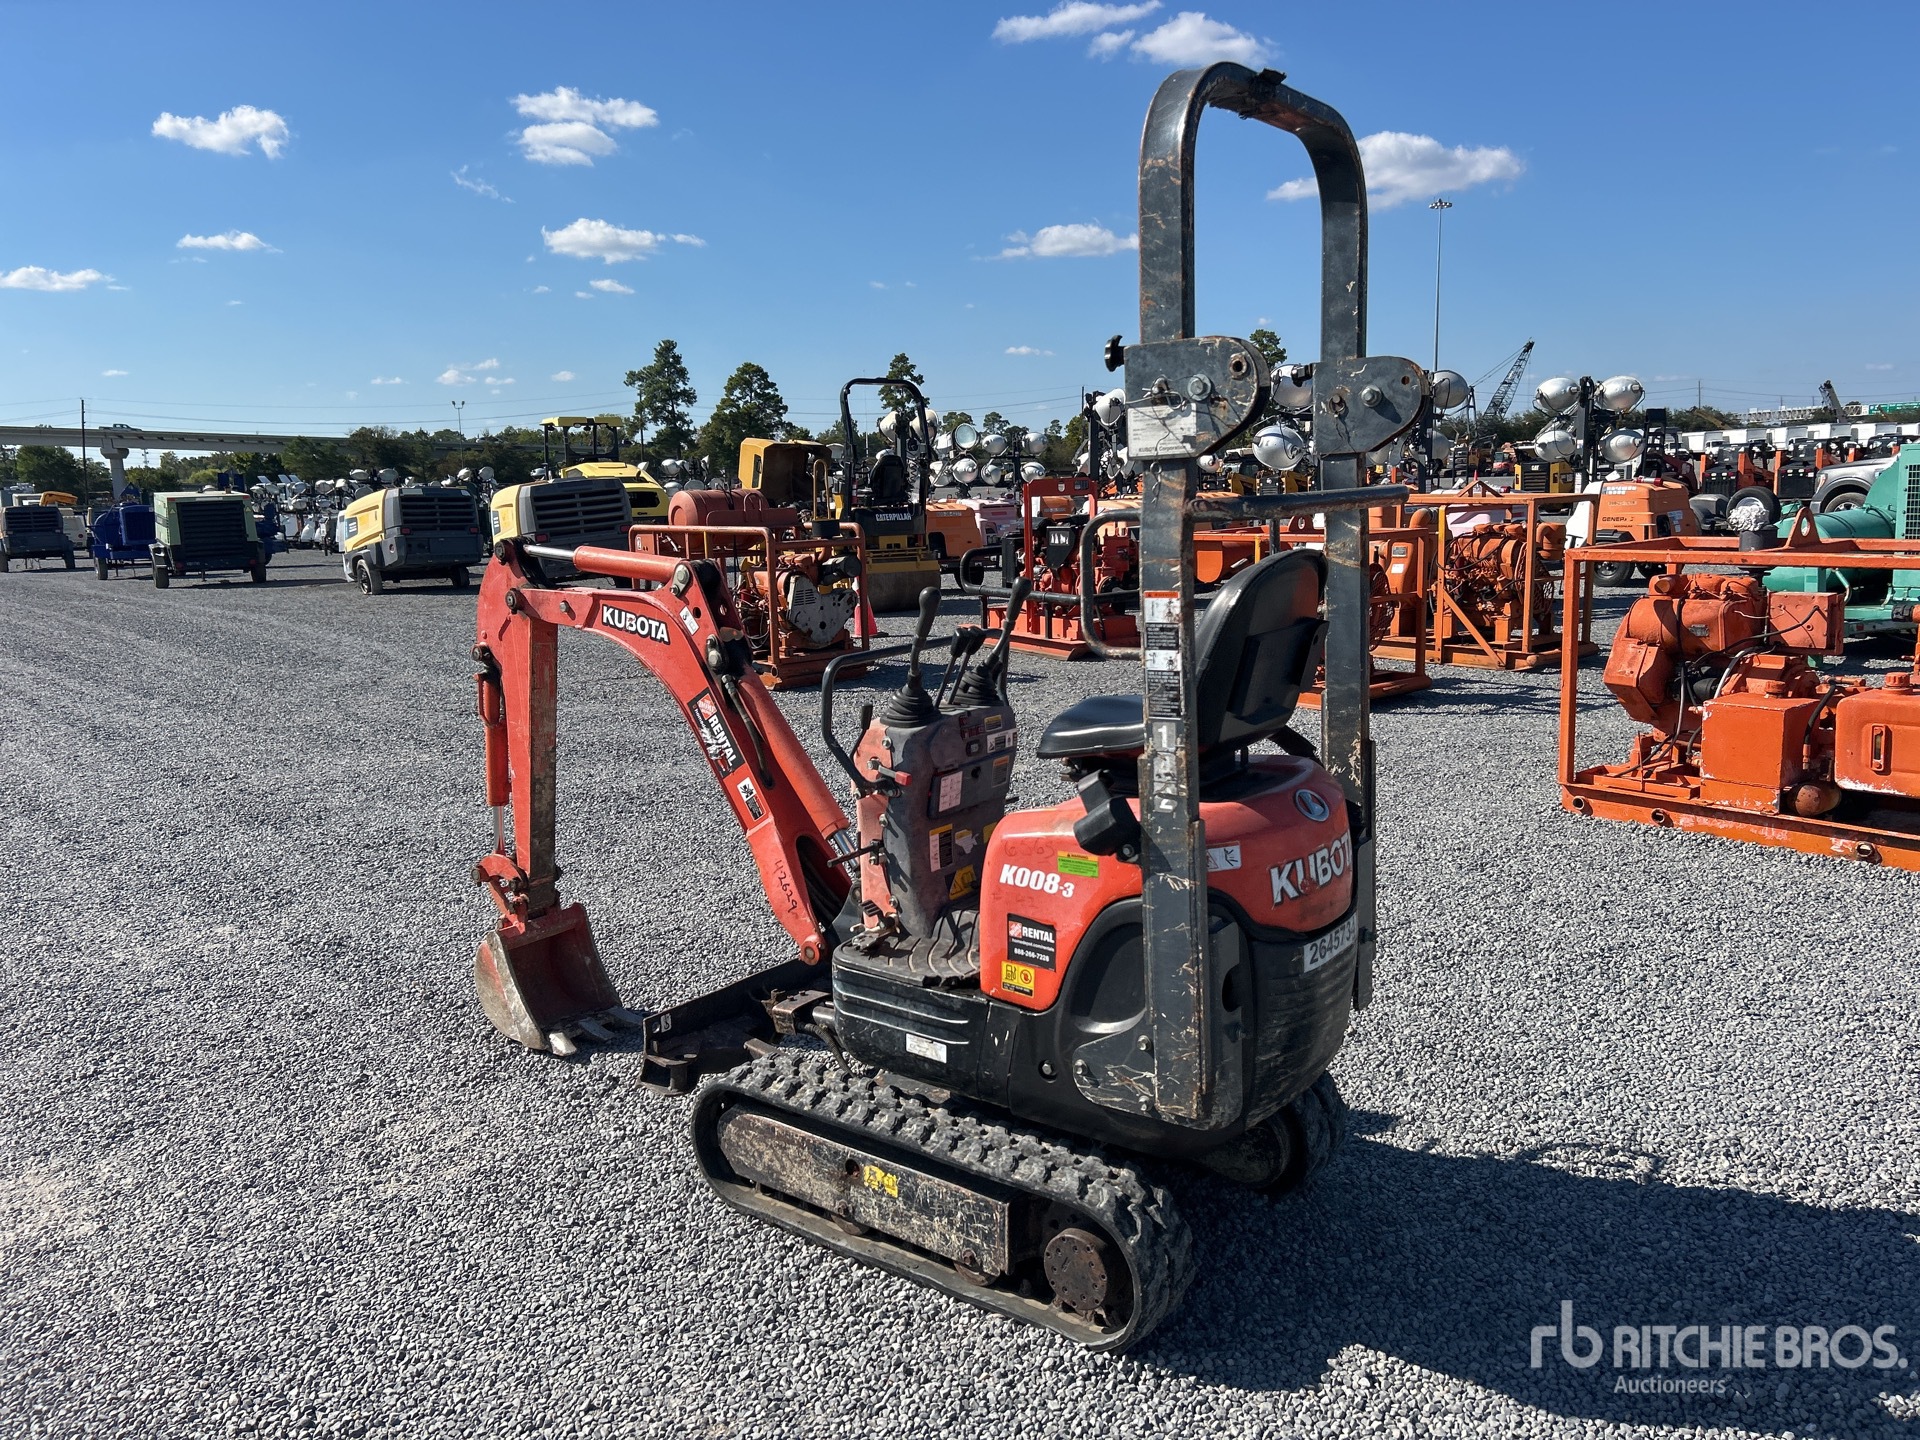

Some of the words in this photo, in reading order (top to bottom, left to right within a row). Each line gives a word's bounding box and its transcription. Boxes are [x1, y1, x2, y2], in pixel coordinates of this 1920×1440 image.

[875, 512, 912, 522] CATERPILLAR
[602, 605, 669, 643] KUBOTA
[708, 714, 737, 766] RENTAL
[1000, 863, 1075, 898] K008-3
[1022, 926, 1055, 944] RENTAL
